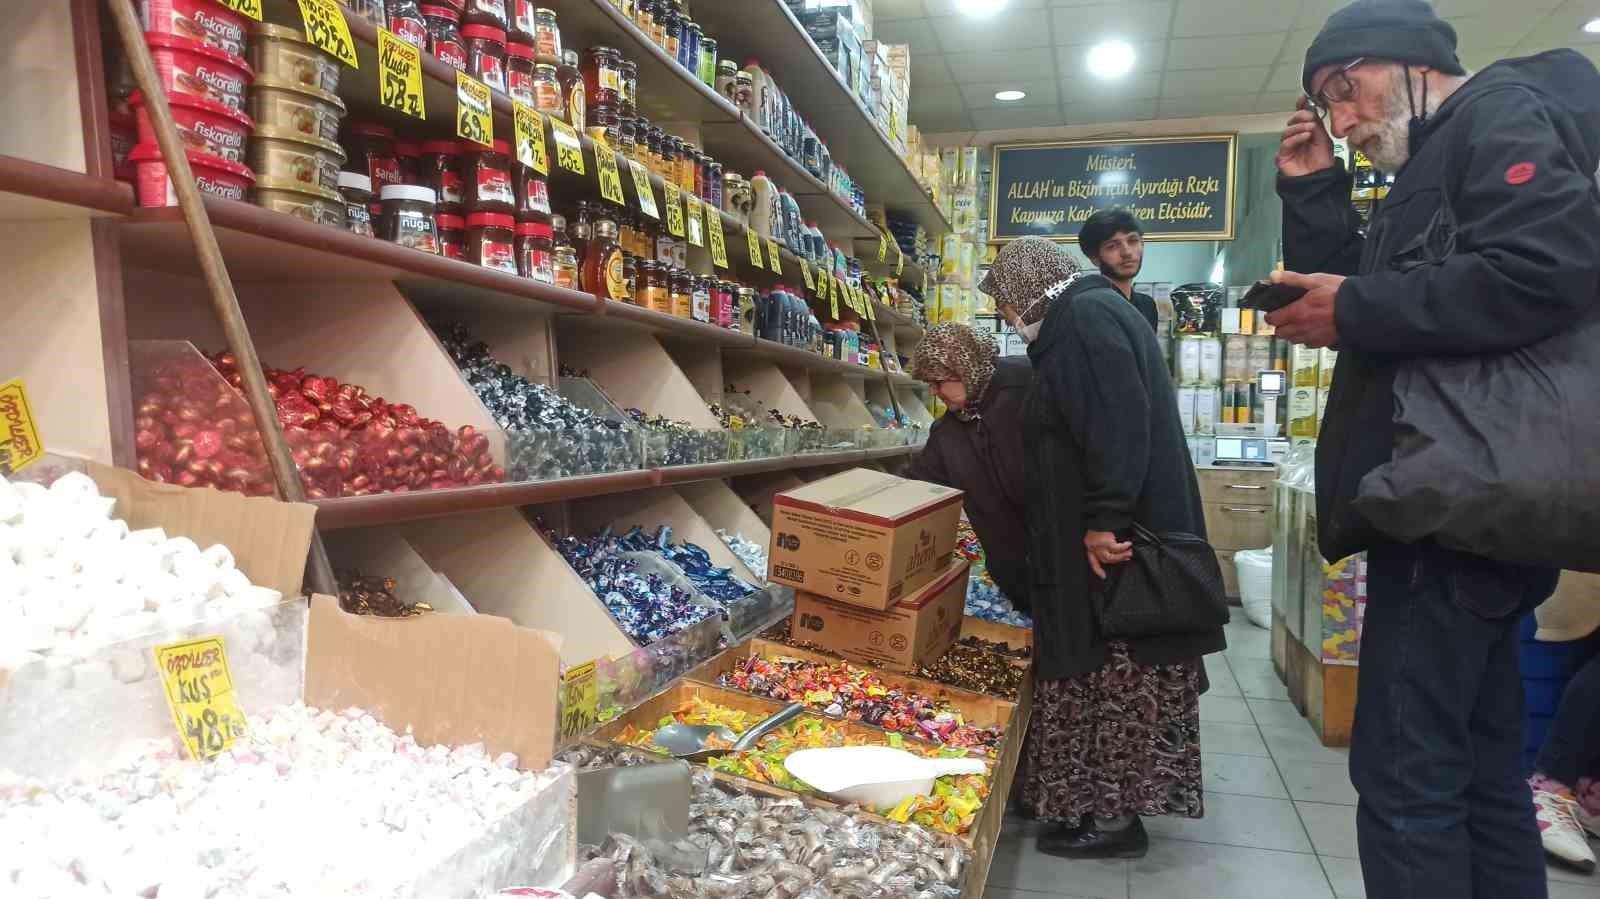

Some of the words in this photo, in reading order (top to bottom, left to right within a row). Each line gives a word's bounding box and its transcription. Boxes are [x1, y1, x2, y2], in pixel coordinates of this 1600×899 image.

[383, 72, 407, 110] 58
[1068, 179, 1102, 200] Bizim
[1131, 177, 1183, 198] Ayırdığı
[1186, 176, 1219, 196] Rızkı
[402, 217, 430, 231] nuga
[1159, 201, 1212, 224] Elçisidir.
[187, 708, 224, 759] 48
